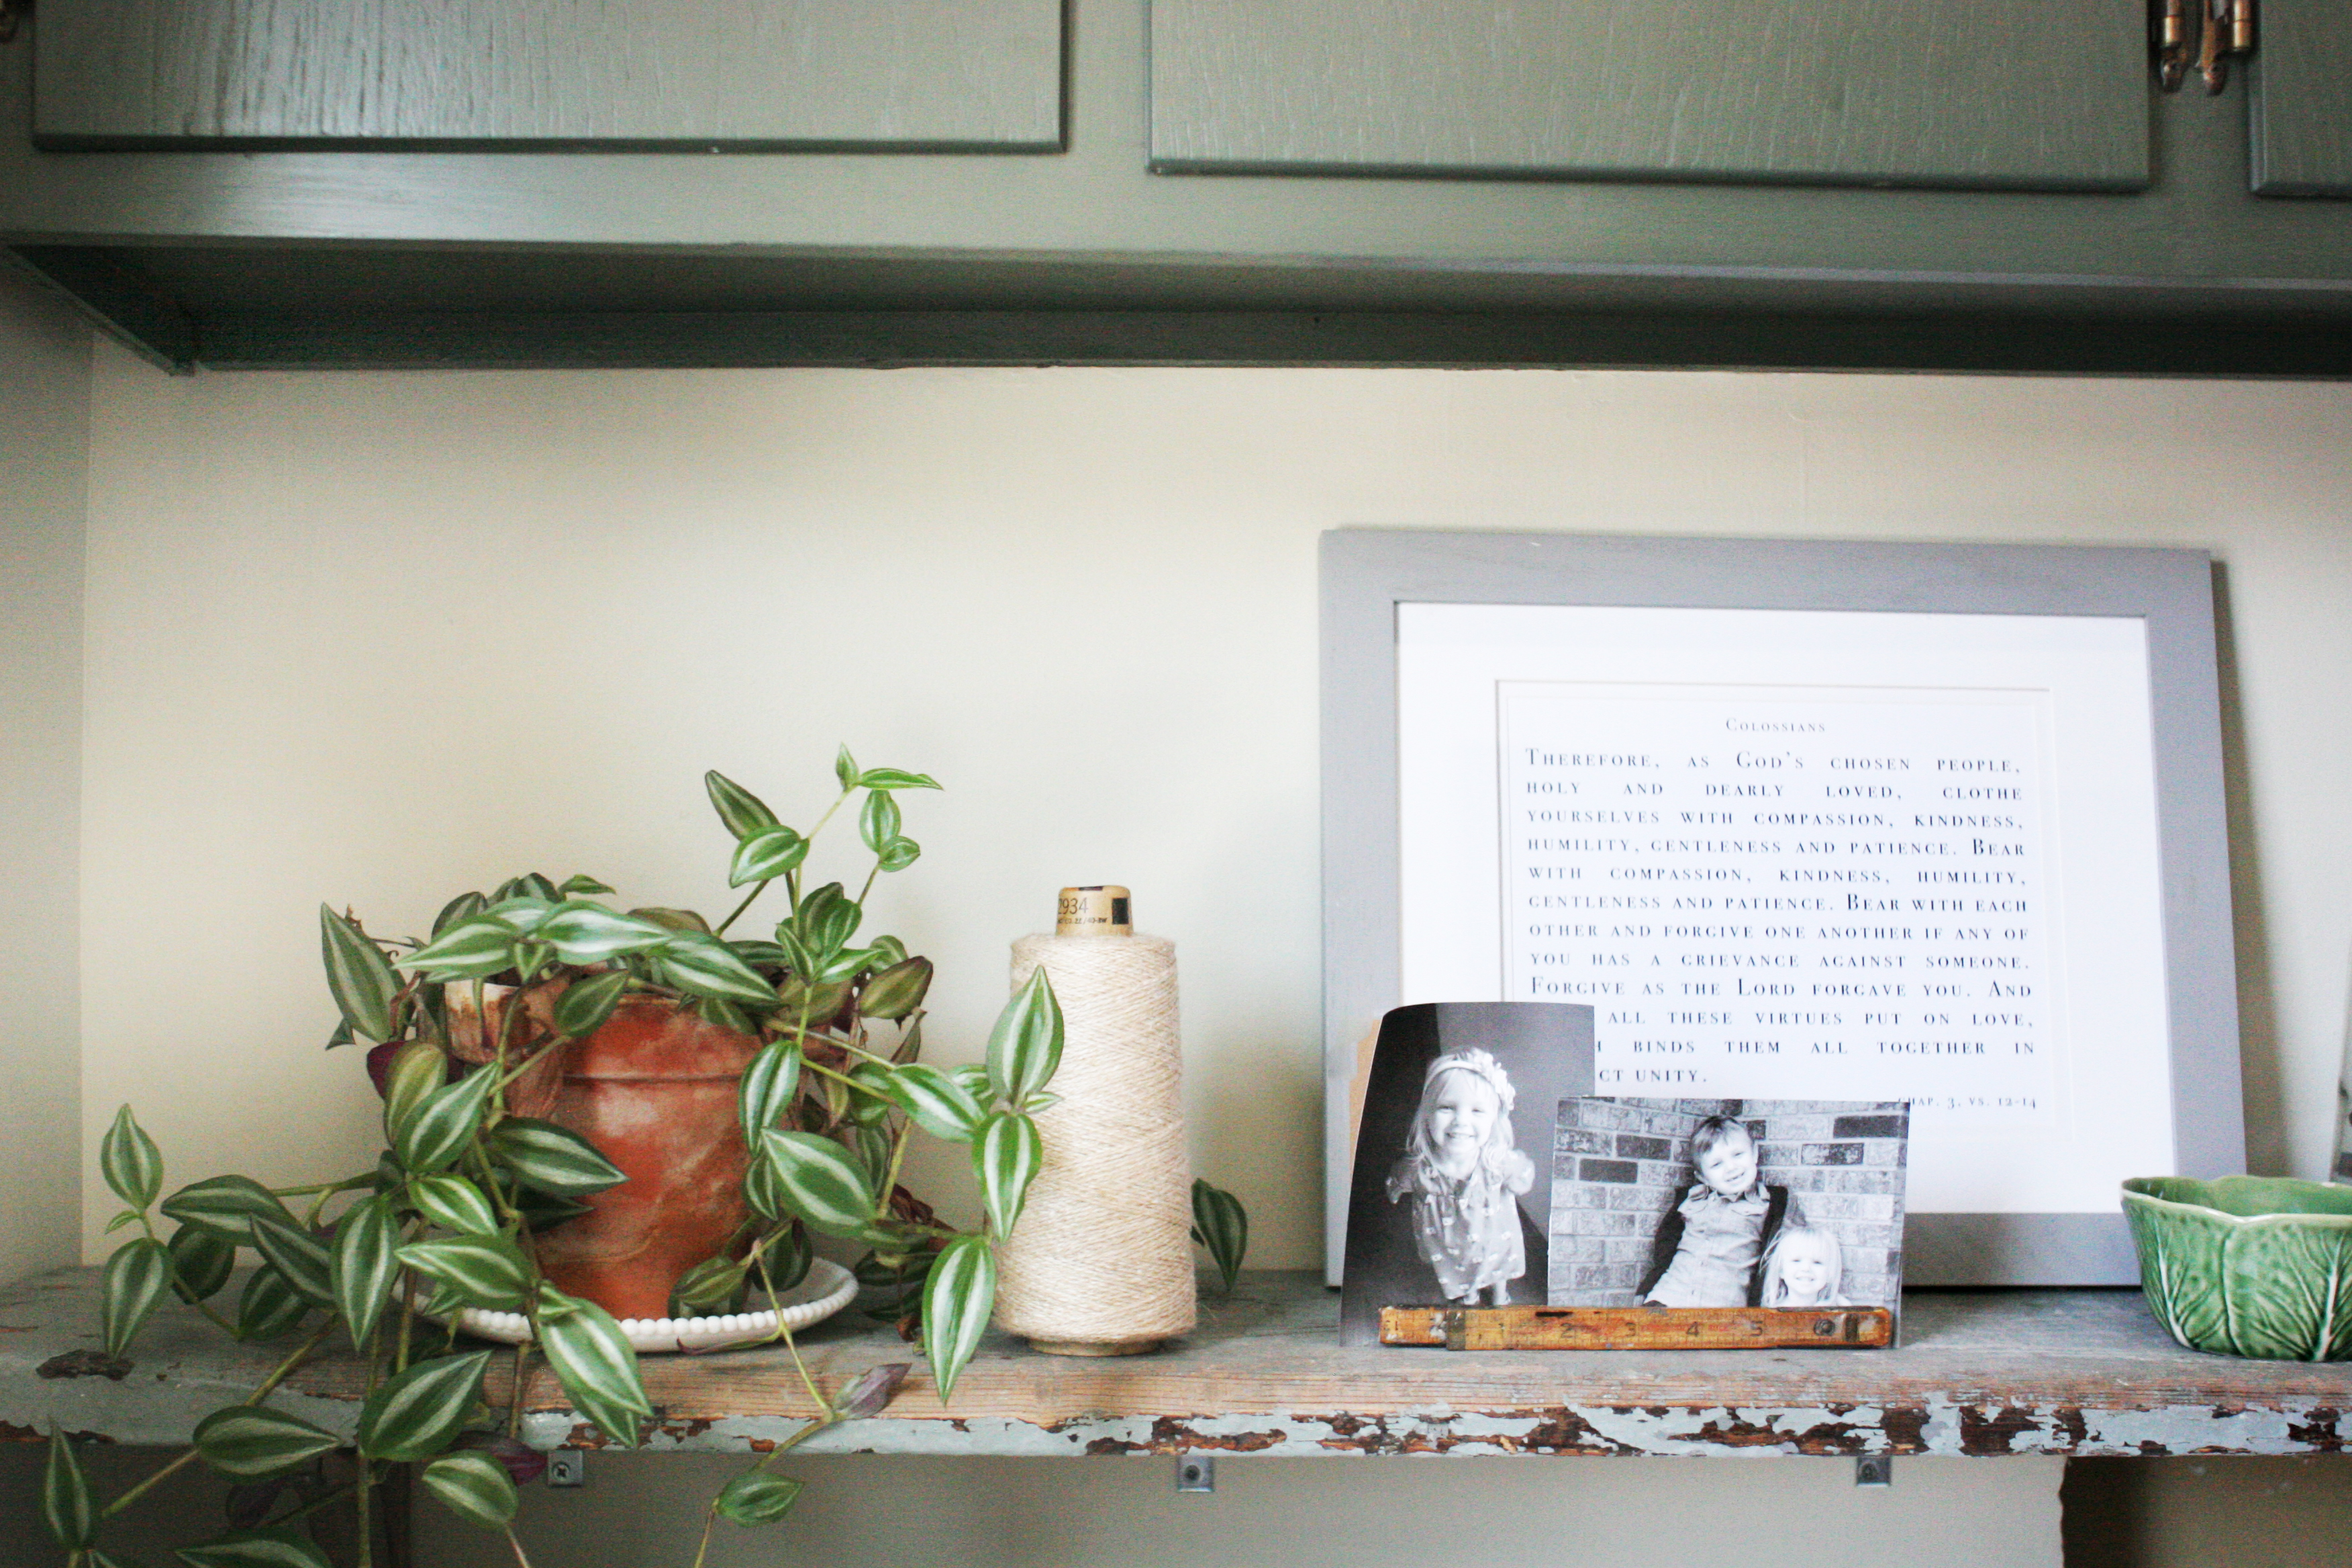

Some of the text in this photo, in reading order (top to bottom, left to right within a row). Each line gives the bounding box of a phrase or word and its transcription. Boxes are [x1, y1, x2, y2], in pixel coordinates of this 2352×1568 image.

[1725, 718, 1825, 732] COLOSSIANS
[1524, 747, 2020, 774] THEREFORE, AS GOD'S CHOSEN PEOPLE,
[1526, 781, 2022, 801] HOLY AND DEARLY LOVED, CLOTHE
[1527, 810, 2023, 830] YOURSELVES WITH COMPASSION, KINDNESS,
[1528, 837, 2025, 856] HUMILITY, GENTLENESS AND PATIENCE. BEAR
[1528, 867, 2026, 887] WITH COMPASSION, KINDNESS, HUMILITY,
[1528, 892, 2027, 913] GENTLENESS AND PATIENCE. BEAR WITH EACH
[1528, 924, 2028, 941] OTHER AND FORGIVE ONE ANOTHER IF ANY OF
[1530, 952, 2029, 970] YOU HAS A GRIEVANCE AGAINST SOMEONE.
[1531, 975, 2032, 998] FORGIVE AS THE LORD FORGAVE YOU. AND
[1608, 1011, 2033, 1028] ALL THESE VIRTUES PUT ON LOVE,
[1633, 1040, 2034, 1055] BINDS THEM ALL TOGETHER IN
[1635, 1069, 1707, 1083] UNITY.
[1998, 1097, 2037, 1110] 12-14
[1624, 1322, 1636, 1336] 3
[1686, 1321, 1699, 1337] 4
[1751, 1320, 1763, 1336] 5
